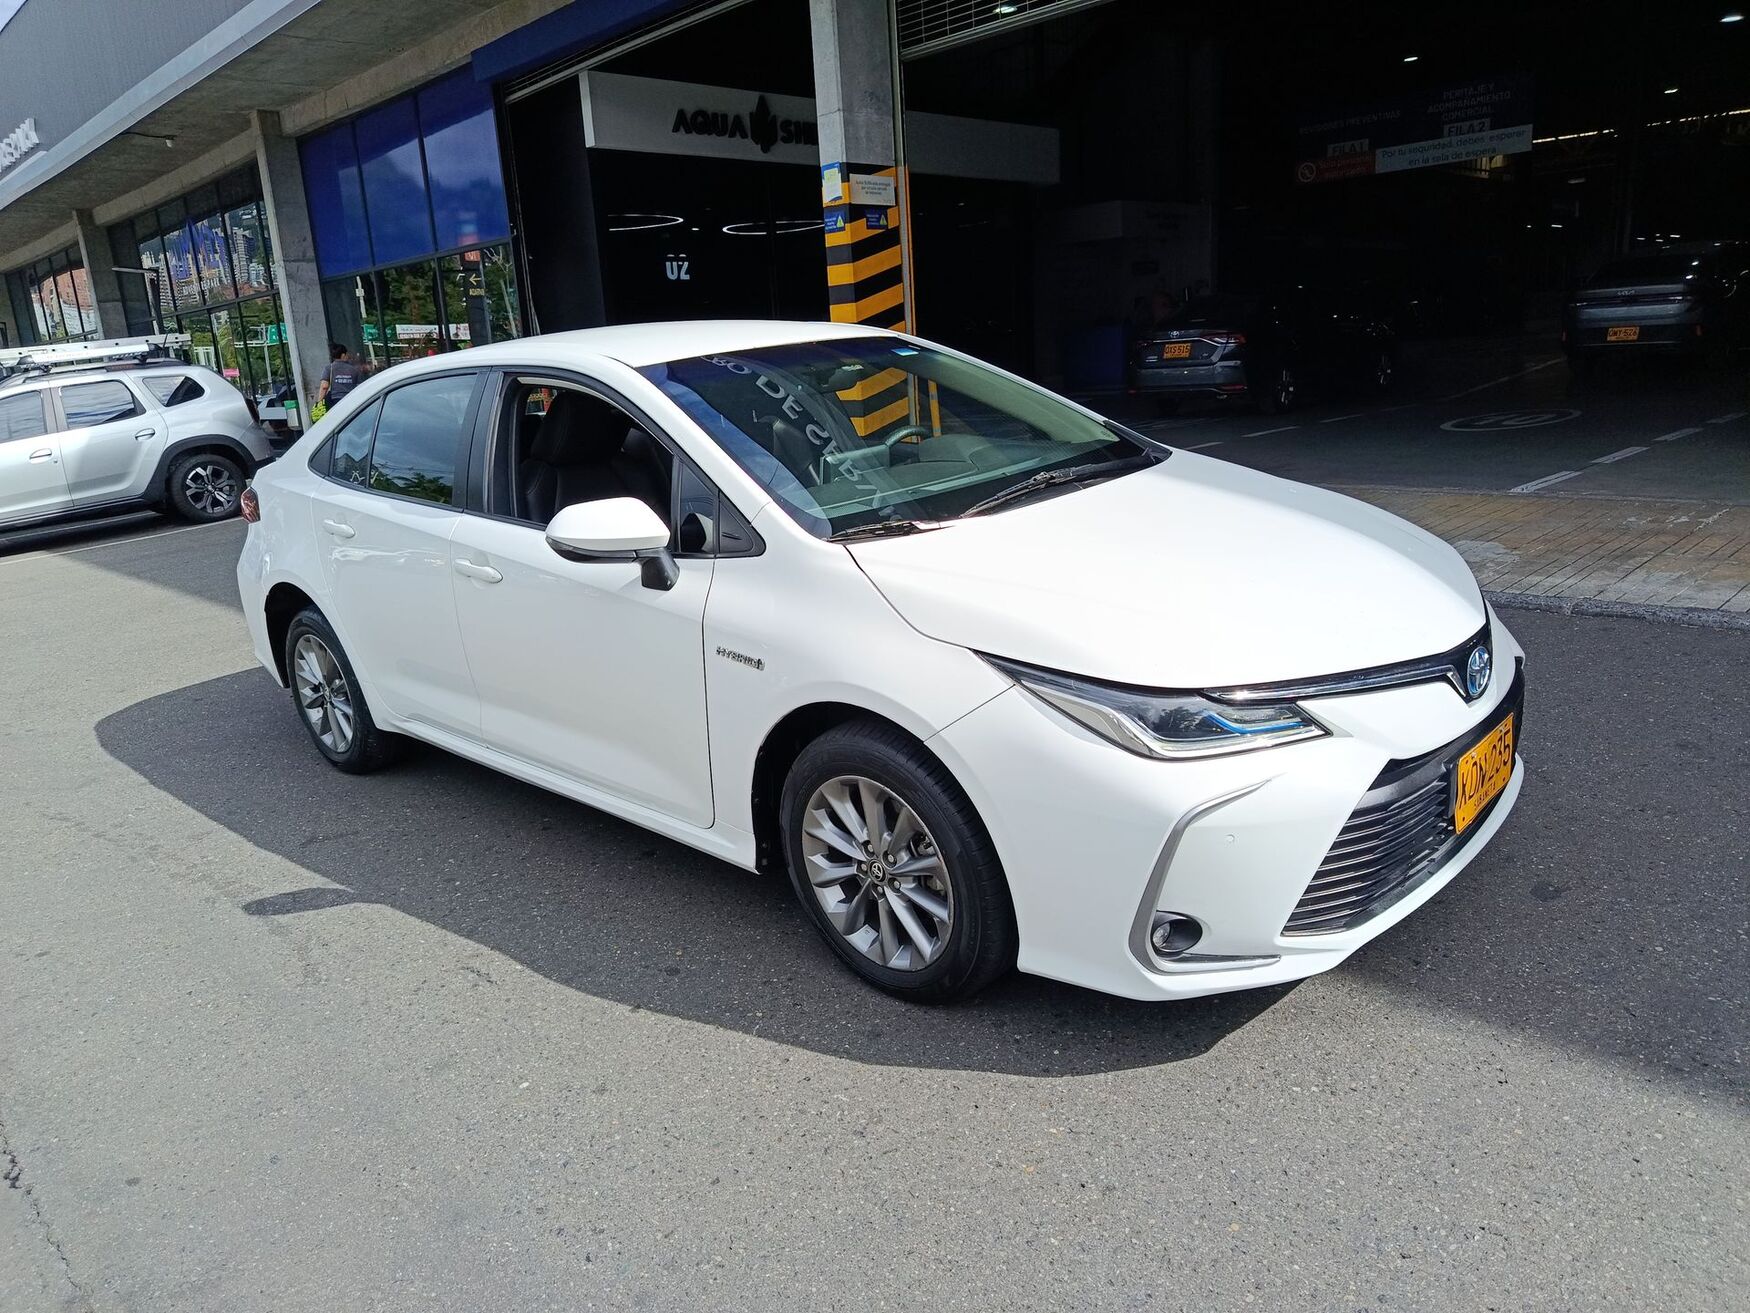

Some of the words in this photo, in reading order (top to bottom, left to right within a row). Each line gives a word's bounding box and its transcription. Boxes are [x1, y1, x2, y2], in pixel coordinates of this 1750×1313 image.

[672, 109, 749, 139] AQUA
[1447, 123, 1475, 137] FILA
[1456, 136, 1484, 147] debes
